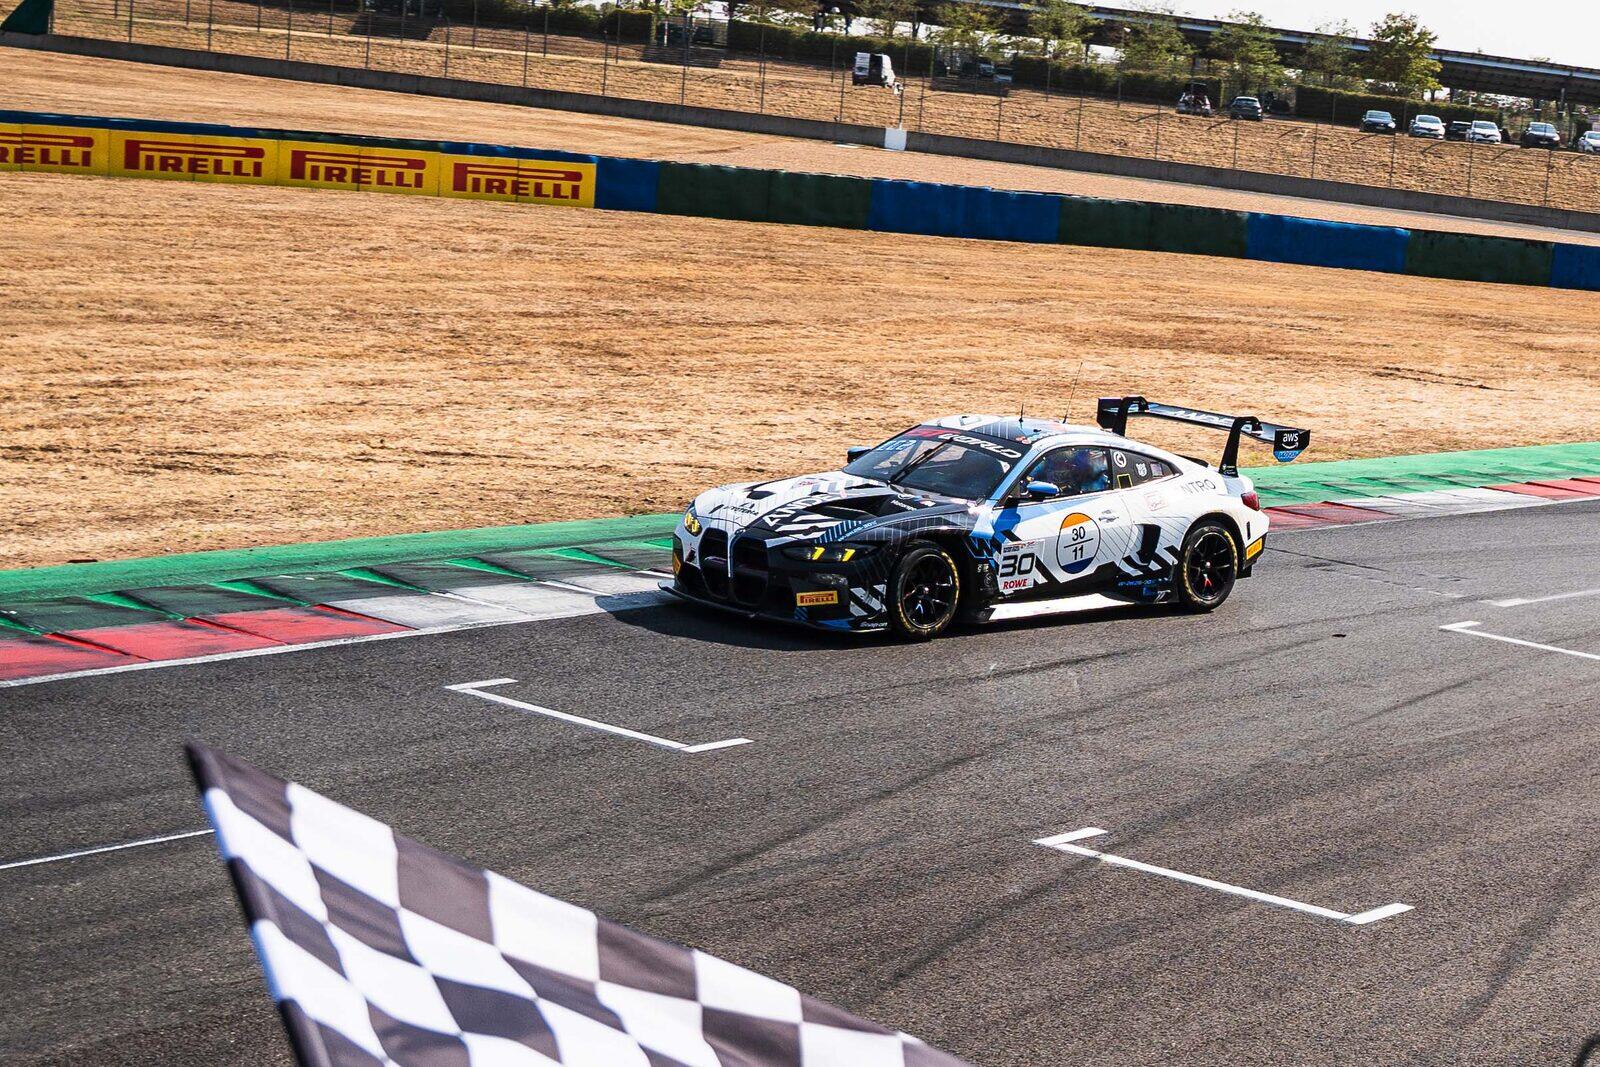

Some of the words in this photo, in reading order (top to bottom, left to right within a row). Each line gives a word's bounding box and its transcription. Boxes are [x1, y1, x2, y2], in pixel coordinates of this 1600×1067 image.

[124, 139, 265, 177] PIRELLI
[290, 150, 427, 188] PIRELLI
[452, 162, 583, 200] PIRELLI
[1282, 433, 1298, 442] aws
[1072, 526, 1086, 542] 30
[1072, 545, 1084, 560] 11
[1000, 552, 1036, 577] 30
[1003, 579, 1028, 590] ROWE
[800, 593, 834, 604] PIRELLI
